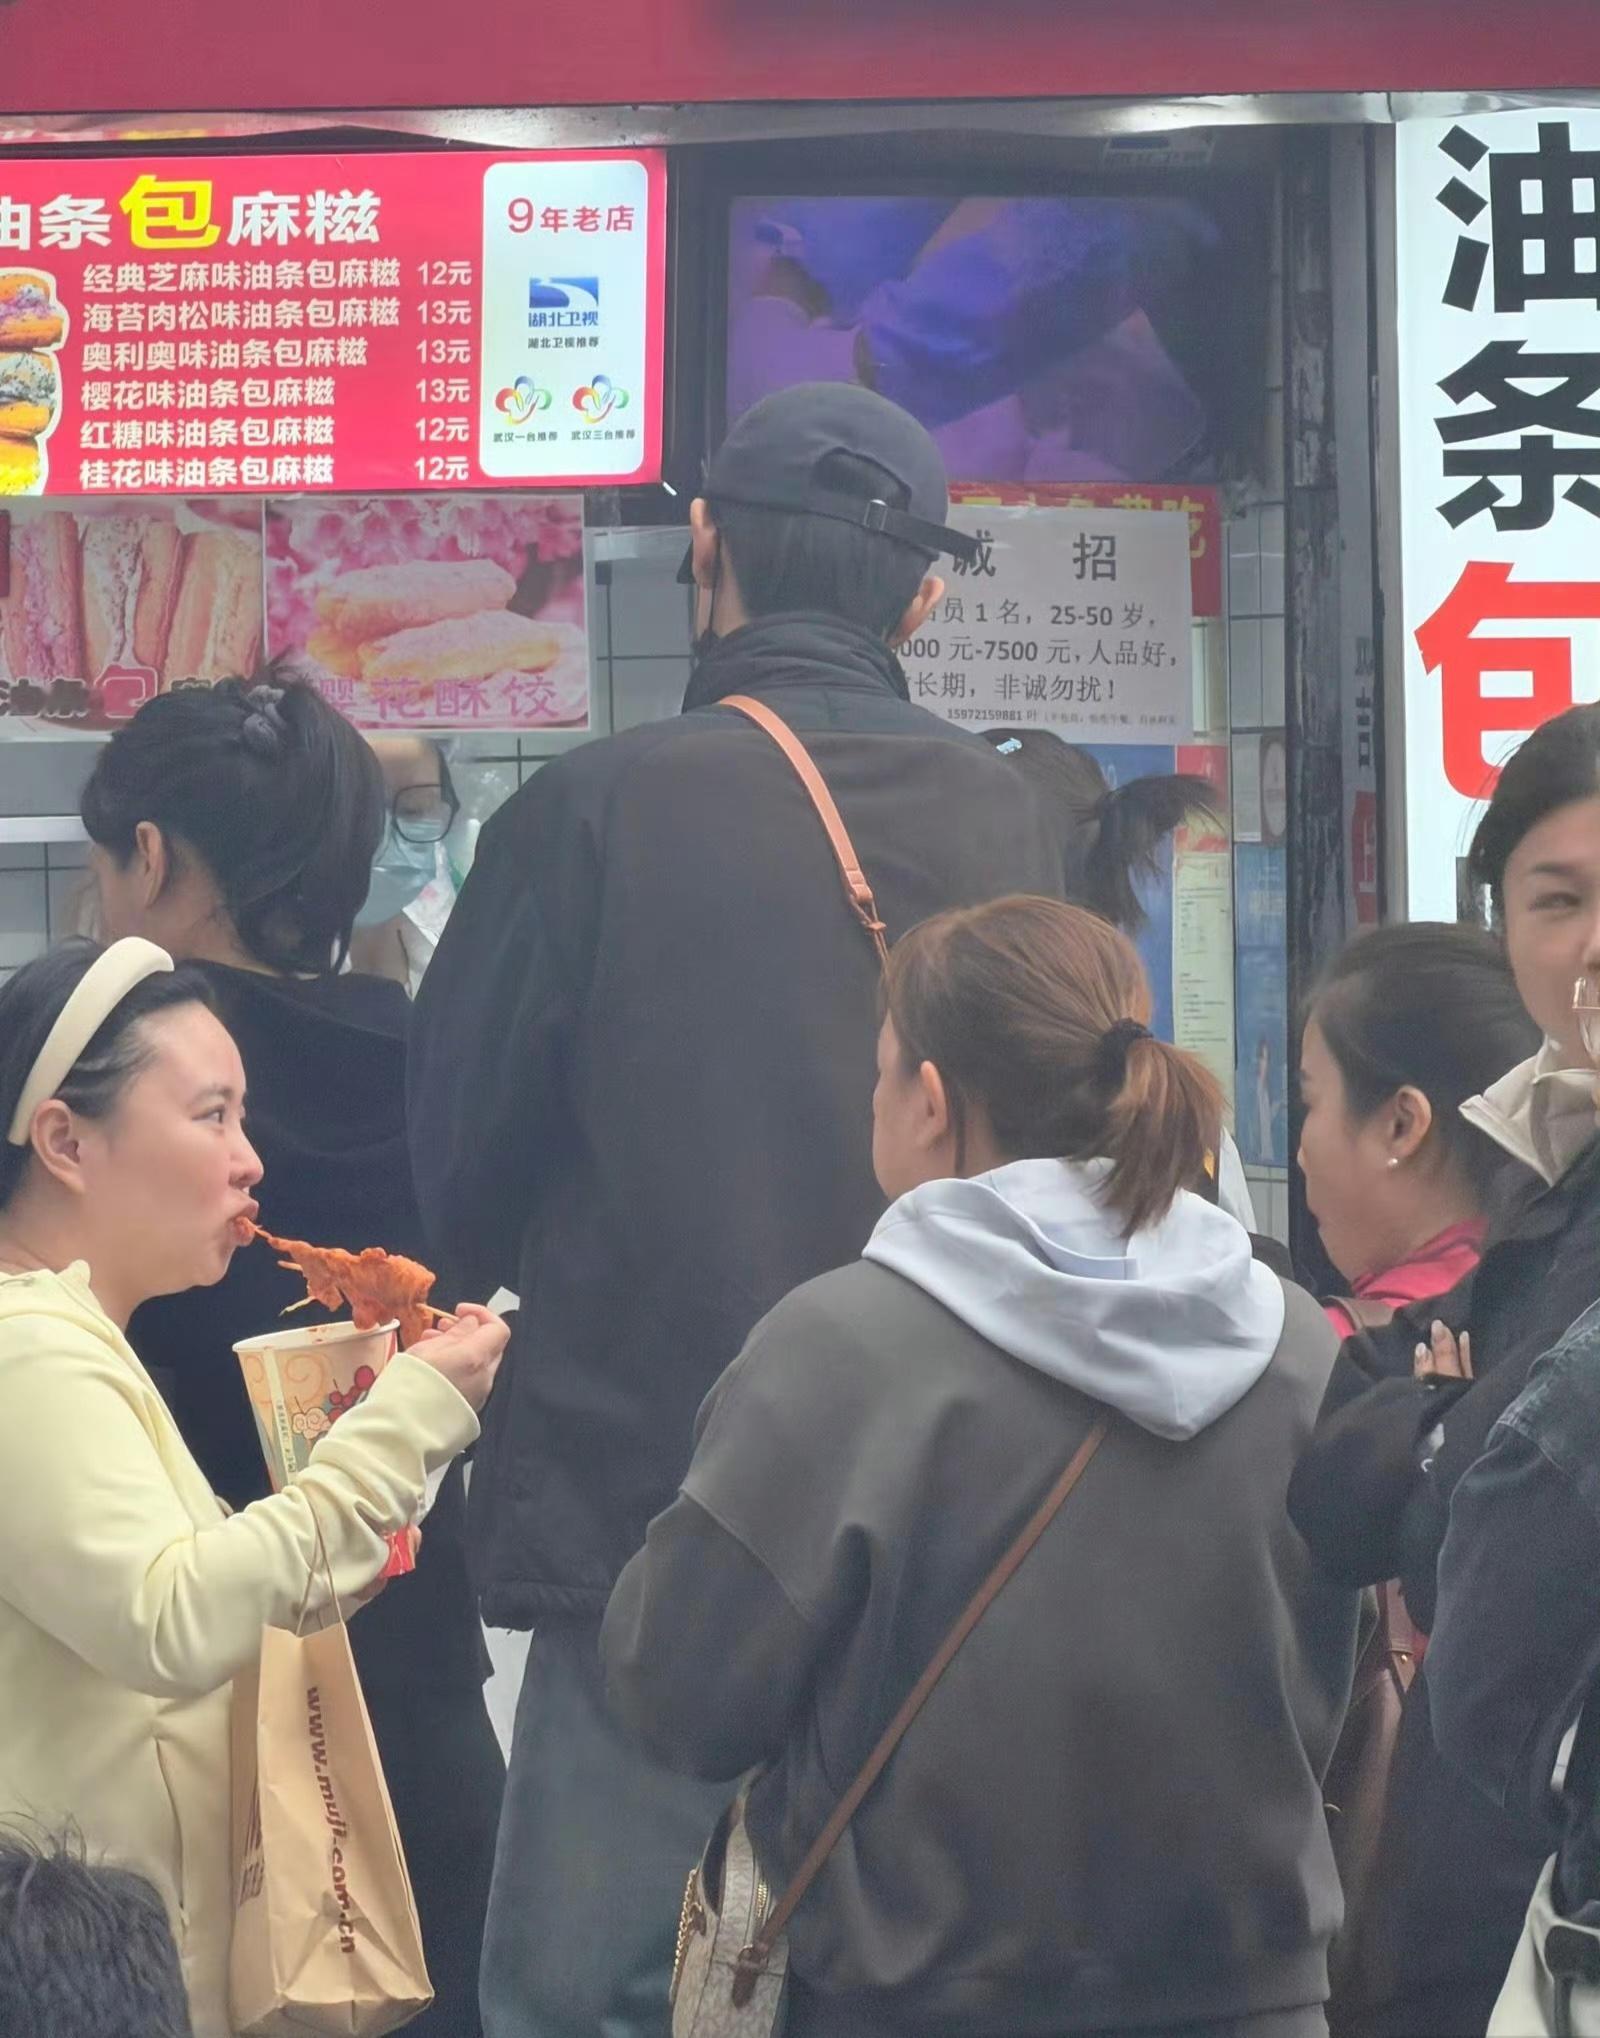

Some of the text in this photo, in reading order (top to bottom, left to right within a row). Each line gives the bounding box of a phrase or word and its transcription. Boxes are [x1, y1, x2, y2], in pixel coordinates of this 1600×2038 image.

[508, 198, 635, 233] 9年老店
[83, 258, 473, 294] 经典芝麻味油条包麻糍 12元
[83, 297, 472, 333] 海苔肉松味油条包麻糍 13元
[528, 311, 599, 328] 湖北卫视
[82, 336, 471, 372] 奥利奥味油条包麻糍 13元
[81, 376, 471, 411] 樱花味油条包麻糍 13元
[79, 415, 470, 450] 红糖味油条包麻糍 12元
[79, 454, 470, 490] 桂花味油条包麻糍 12元
[1072, 532, 1117, 581] 招
